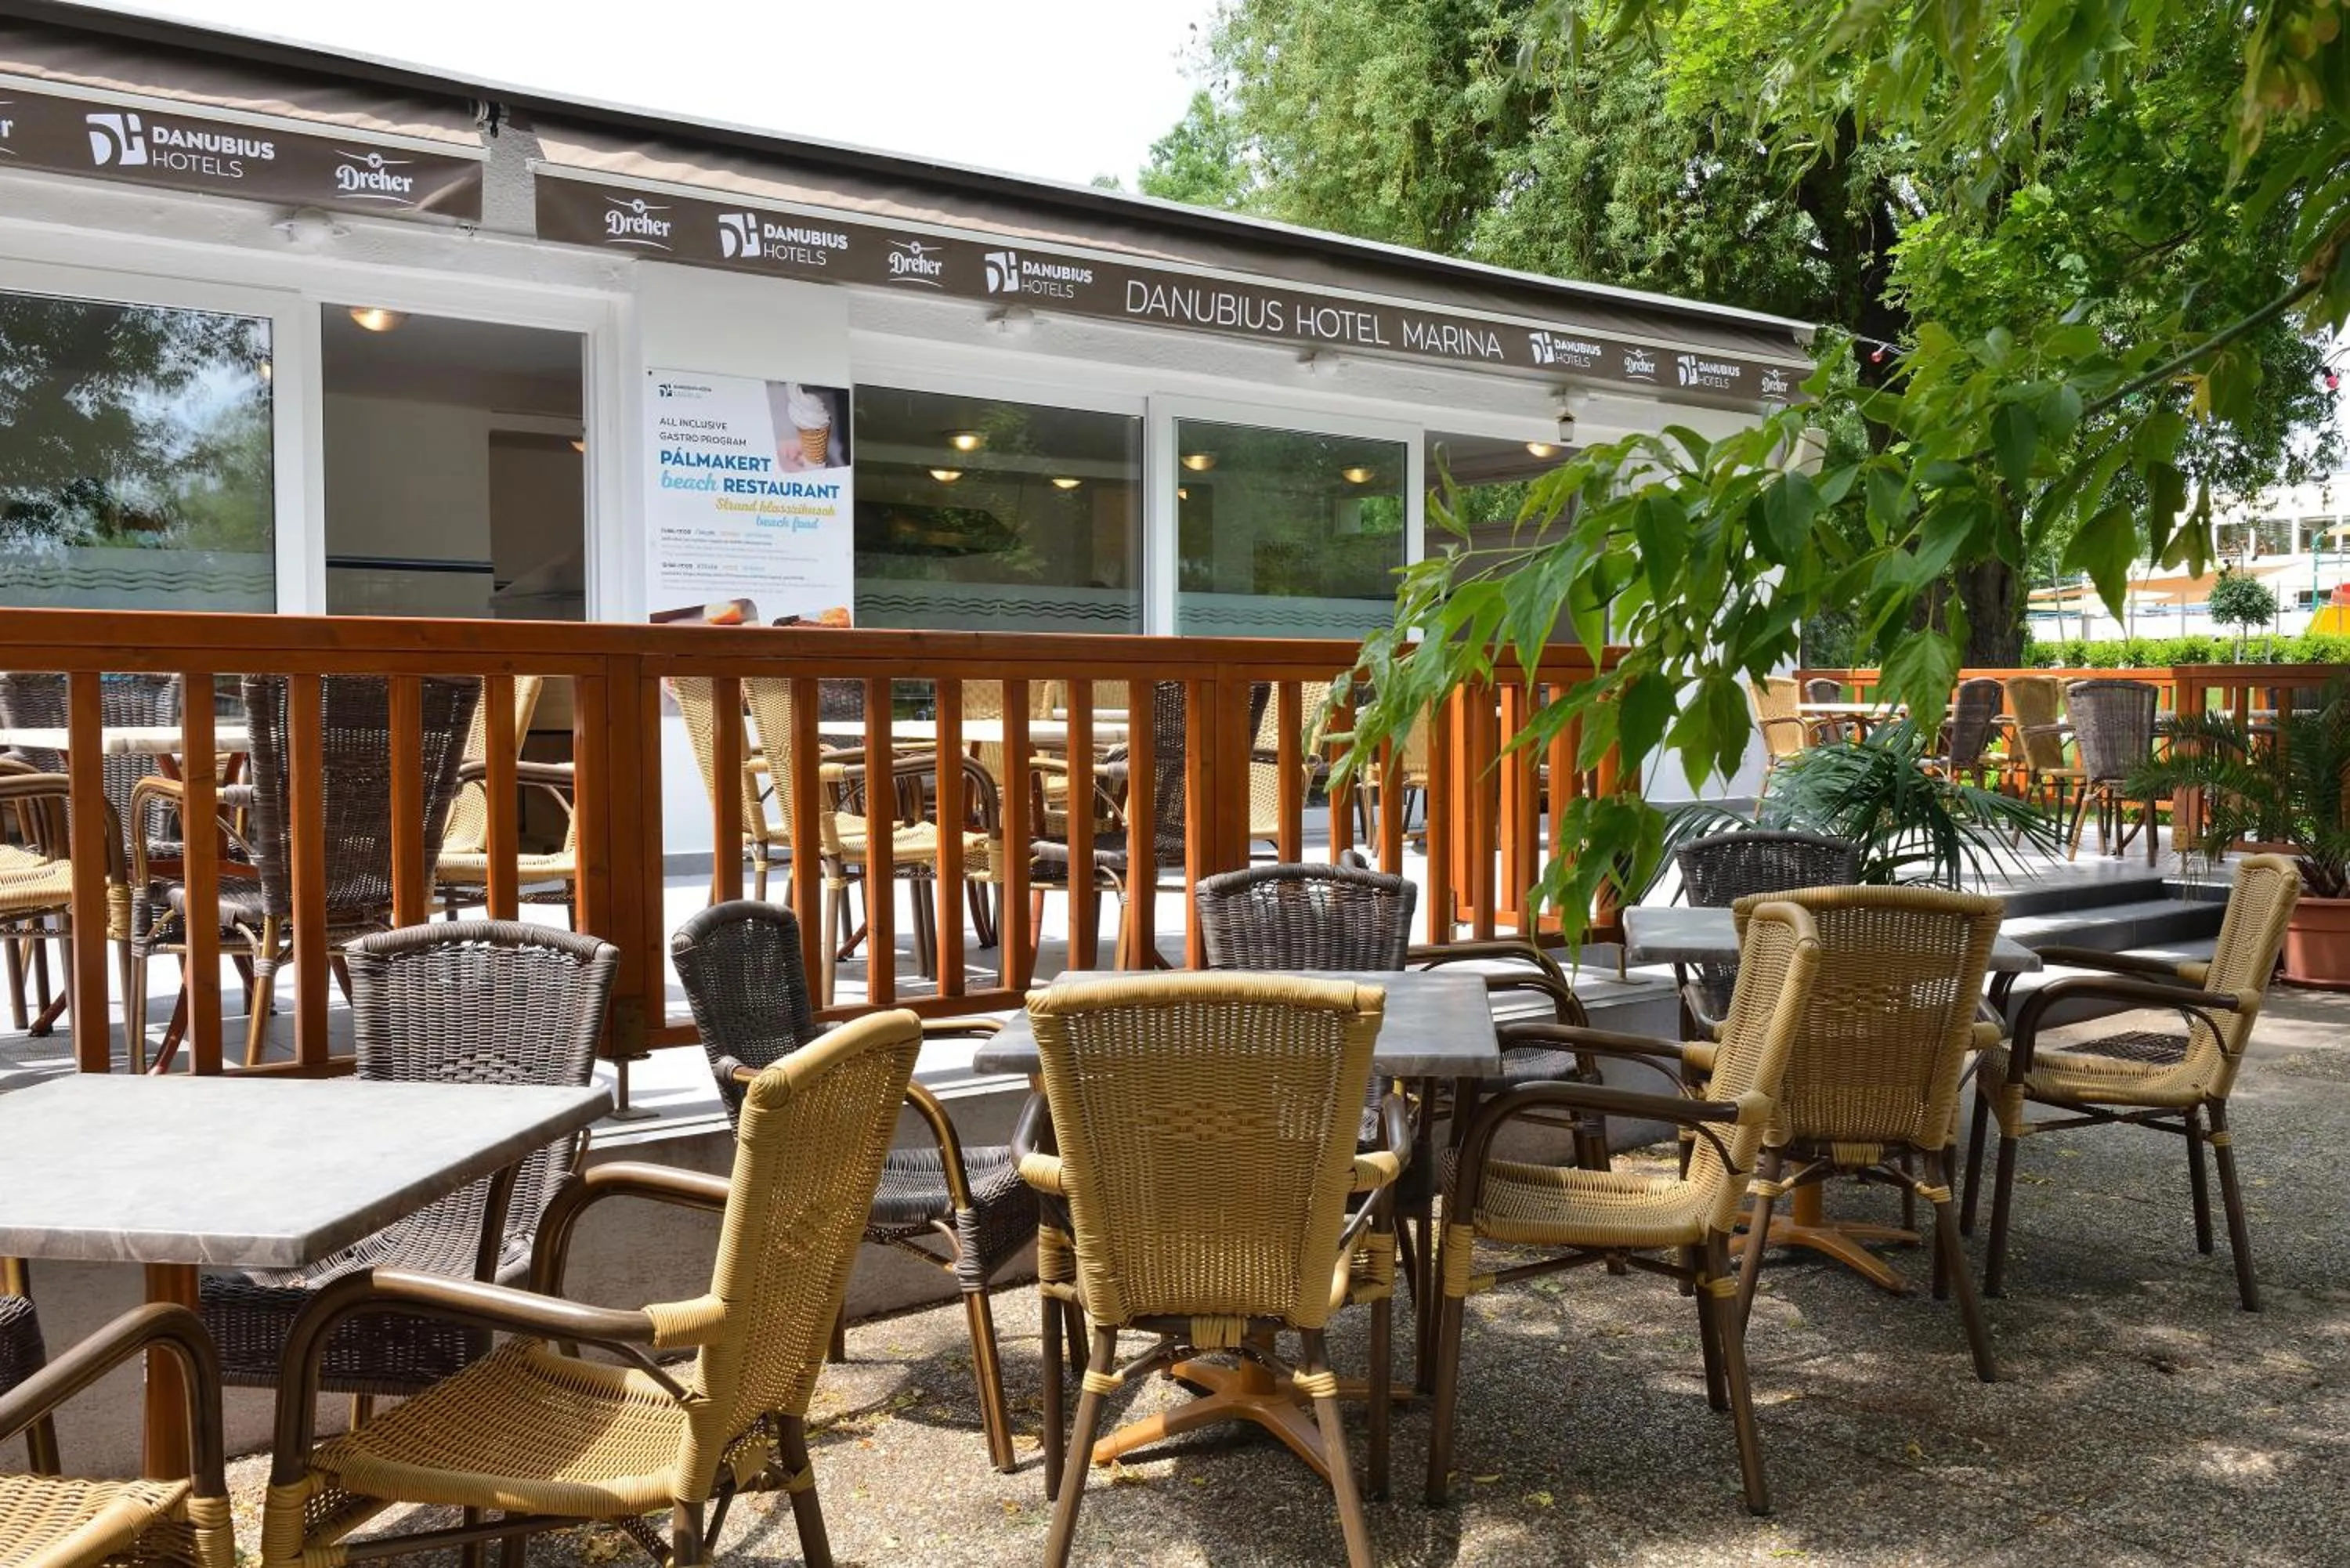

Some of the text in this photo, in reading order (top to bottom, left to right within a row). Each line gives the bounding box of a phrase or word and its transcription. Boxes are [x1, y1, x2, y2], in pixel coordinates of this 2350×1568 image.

[153, 126, 275, 161] DANUBIUS
[153, 150, 244, 178] HOTELS
[335, 164, 414, 193] Dreher
[605, 210, 671, 237] Dreher
[764, 223, 849, 251] DANUBIUS
[764, 242, 827, 266] HOTELS
[888, 251, 943, 276] Dreher
[1021, 260, 1094, 284] DANUBIUS
[1021, 280, 1076, 299] HOTELS
[1126, 280, 1505, 359] DANUBIUS HOTEL MARINA
[1554, 338, 1602, 356] DANUBIUS
[1555, 352, 1592, 368] HOTELS
[1698, 361, 1741, 377] DANUBIUS
[1698, 375, 1730, 389] HOTELS
[660, 417, 728, 431] ALL INCLUSIVE
[659, 432, 747, 446] GASTRO PROGRAM
[660, 446, 772, 471] PÁLMAKERT
[660, 470, 841, 499] beach RESTAURANT
